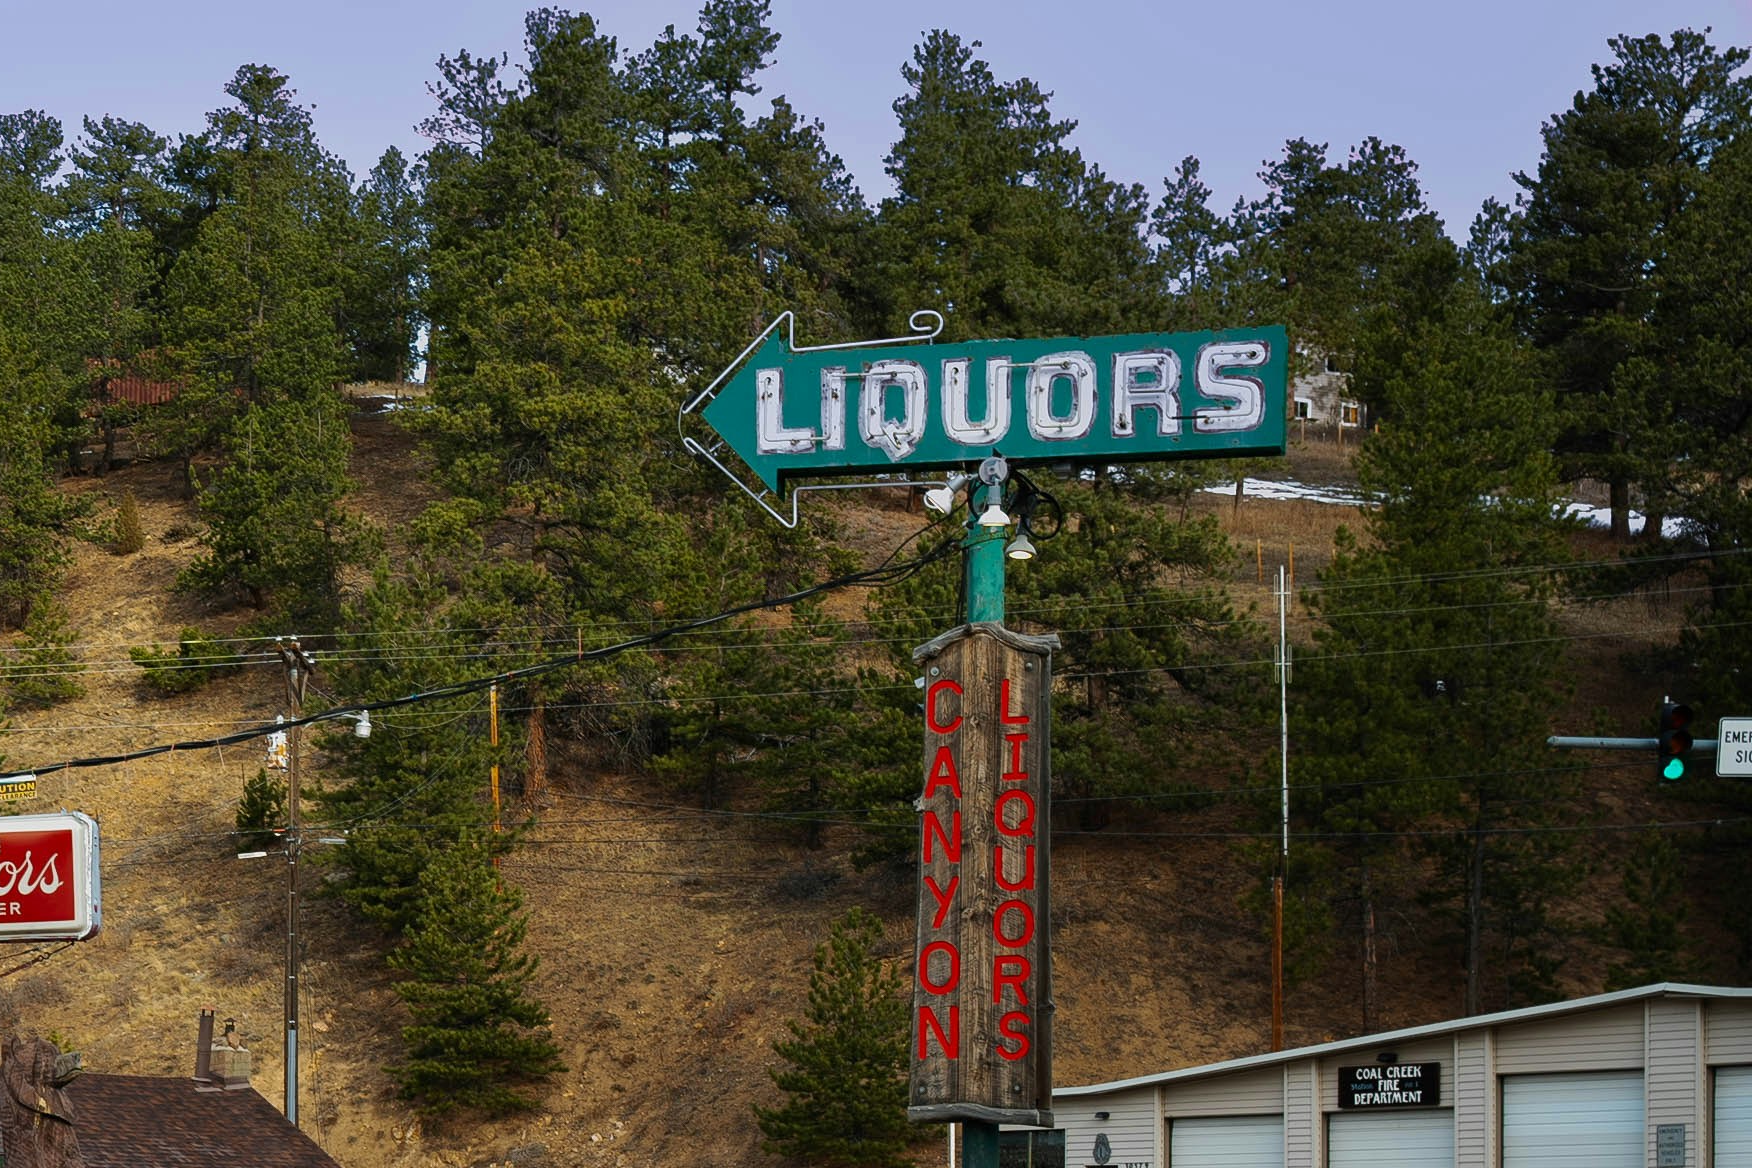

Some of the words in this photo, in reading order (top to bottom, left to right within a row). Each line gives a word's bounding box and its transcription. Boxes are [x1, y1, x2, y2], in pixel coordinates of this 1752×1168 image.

[755, 339, 1271, 462] LIQUORS
[917, 678, 965, 1061] CANYON
[992, 677, 1036, 1062] LIQUORS
[1354, 1090, 1422, 1105] DEPARTMENT
[1355, 1067, 1383, 1080] COAL
[1386, 1065, 1422, 1078] CREEK
[1378, 1079, 1400, 1092] FIRE
